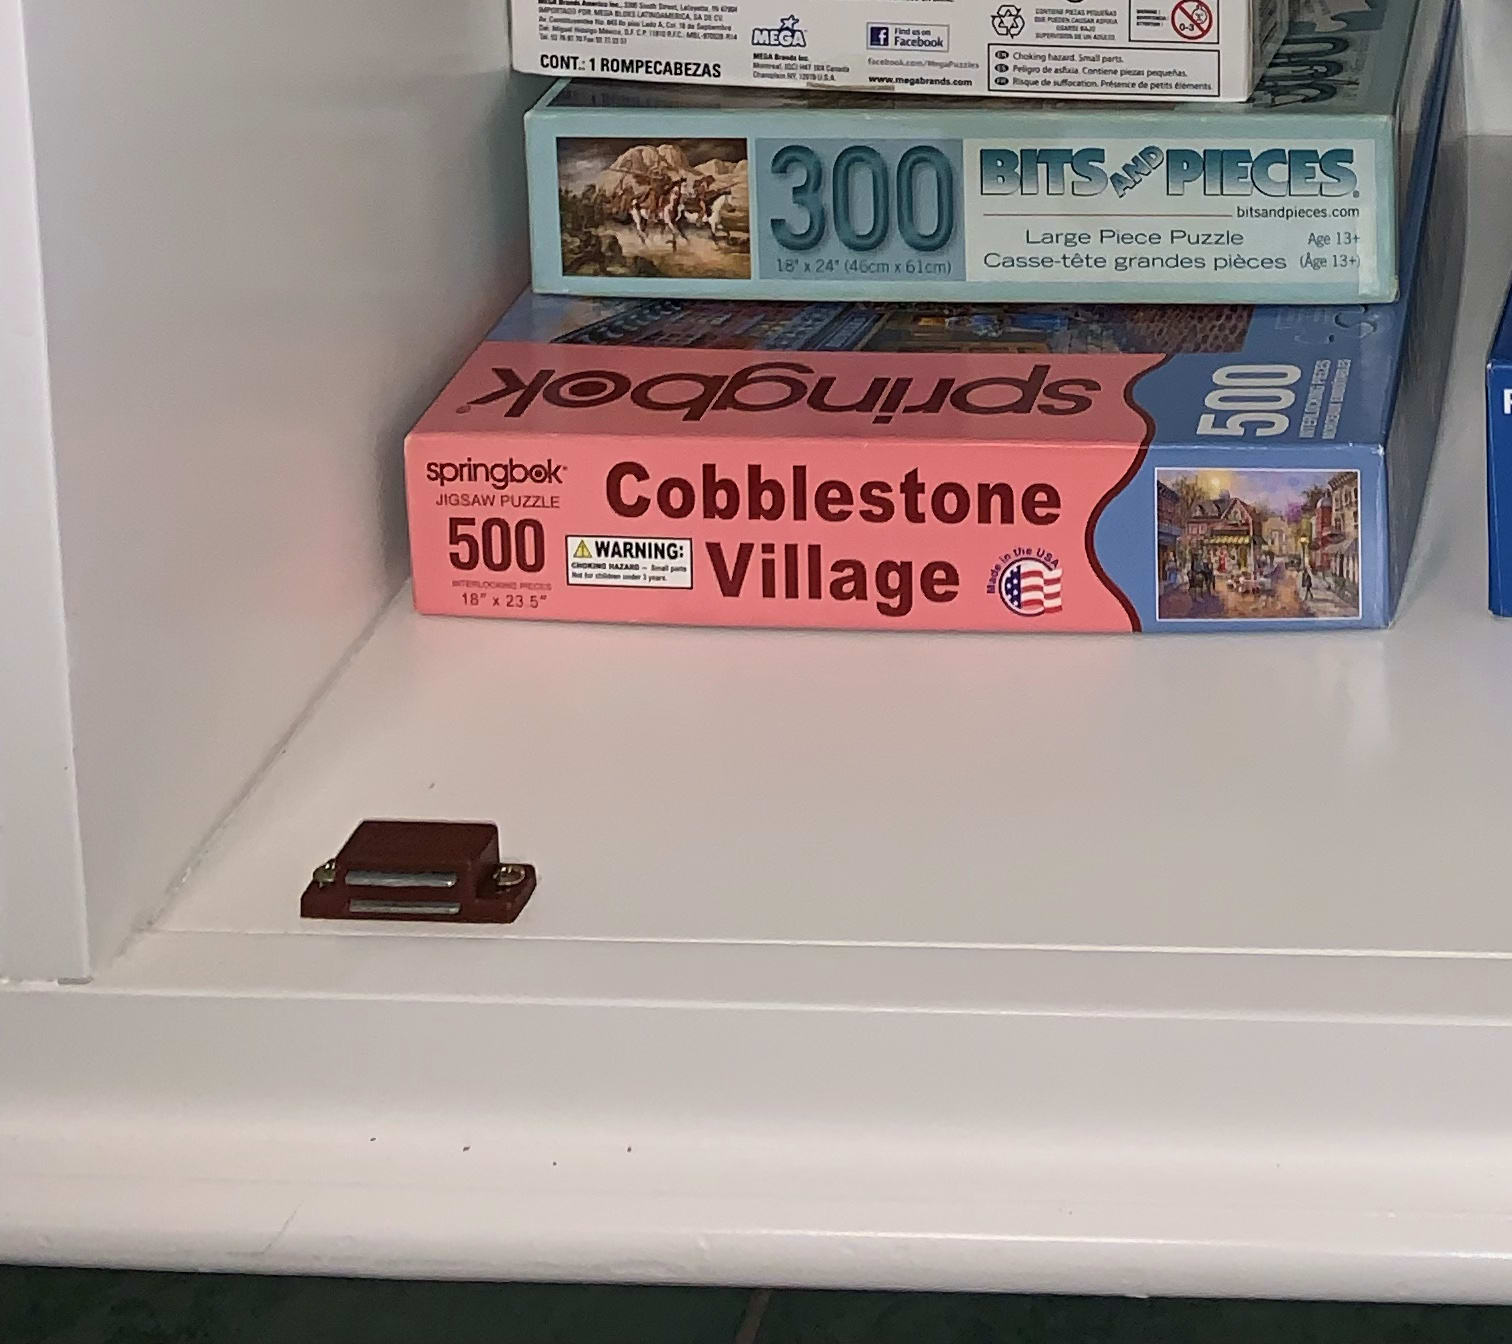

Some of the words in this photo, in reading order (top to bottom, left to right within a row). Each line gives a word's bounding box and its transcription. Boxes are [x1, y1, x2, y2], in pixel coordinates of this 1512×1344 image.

[751, 27, 807, 48] MEGA
[1178, 22, 1195, 32] 0-3
[893, 36, 945, 49] Facebook
[589, 57, 597, 72] 1
[600, 57, 722, 78] ROMPECABEZAS
[867, 74, 974, 88] www.megabrands.com
[979, 147, 1109, 198] BITS
[1109, 145, 1166, 199] AND
[1165, 147, 1357, 198] PIECES
[769, 143, 954, 253] 300
[1236, 206, 1361, 221] bitsandpieces.com
[1025, 229, 1092, 250] Large
[1099, 228, 1162, 247] Piece
[1169, 228, 1245, 247] Puzzle
[1307, 231, 1331, 248] Age
[1335, 230, 1361, 246] 13+
[982, 251, 1108, 270] Casse-tête
[1113, 253, 1207, 273] grandes
[1213, 252, 1287, 272] pièces
[472, 360, 1103, 423] springbok
[1196, 362, 1303, 439] 500
[425, 456, 564, 491] springbok
[435, 492, 496, 509] JIGSAW
[500, 493, 561, 510] PUZZLE
[605, 460, 1063, 527] Cobblestone
[447, 515, 546, 574] 500
[594, 540, 685, 561] WARNING:
[704, 540, 960, 619] Village
